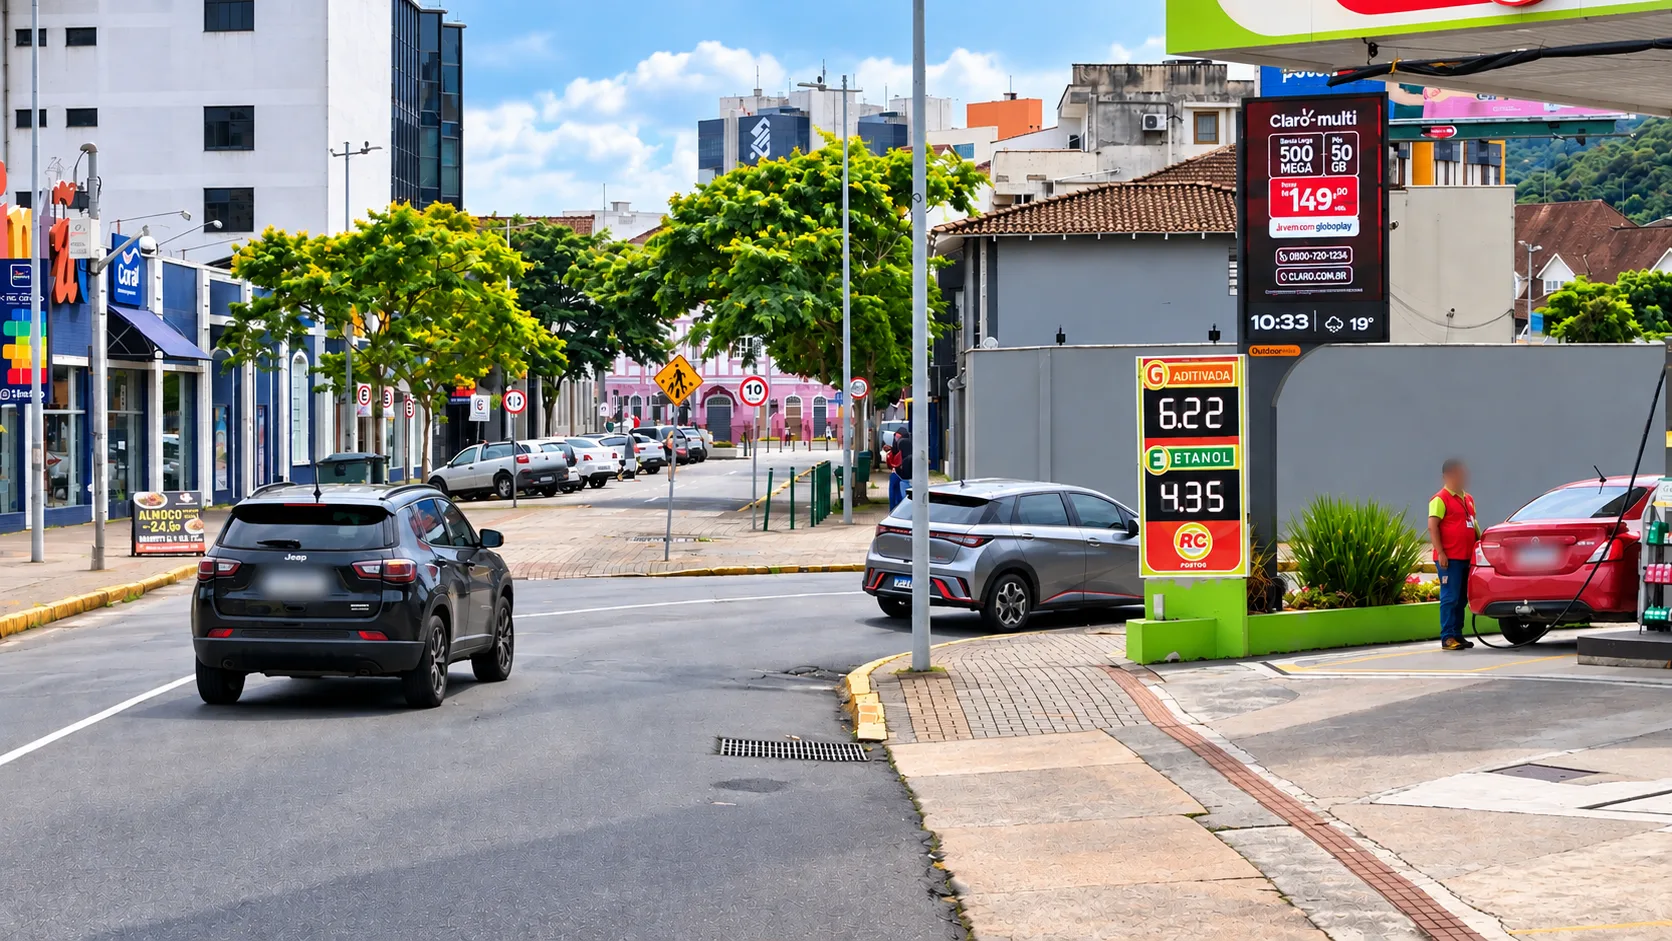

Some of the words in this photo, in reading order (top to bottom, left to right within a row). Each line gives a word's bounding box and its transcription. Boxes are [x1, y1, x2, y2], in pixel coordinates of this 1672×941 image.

[1280, 145, 1313, 162] 500
[1331, 144, 1353, 161] 50
[1281, 162, 1313, 174] MEGA
[1331, 161, 1347, 172] GB
[1316, 222, 1352, 232] globoplay
[1288, 271, 1347, 281] CLARO.COM.BR
[1250, 314, 1309, 330] 10:33
[1349, 317, 1374, 331] 19°
[1173, 371, 1231, 382] ADITIVADA
[746, 384, 762, 395] 10
[1159, 397, 1224, 430] 6.22
[1174, 452, 1231, 464] ETANOL
[1160, 481, 1225, 513] 4.35
[1179, 532, 1207, 549] RC
[284, 553, 308, 562] Jeep
